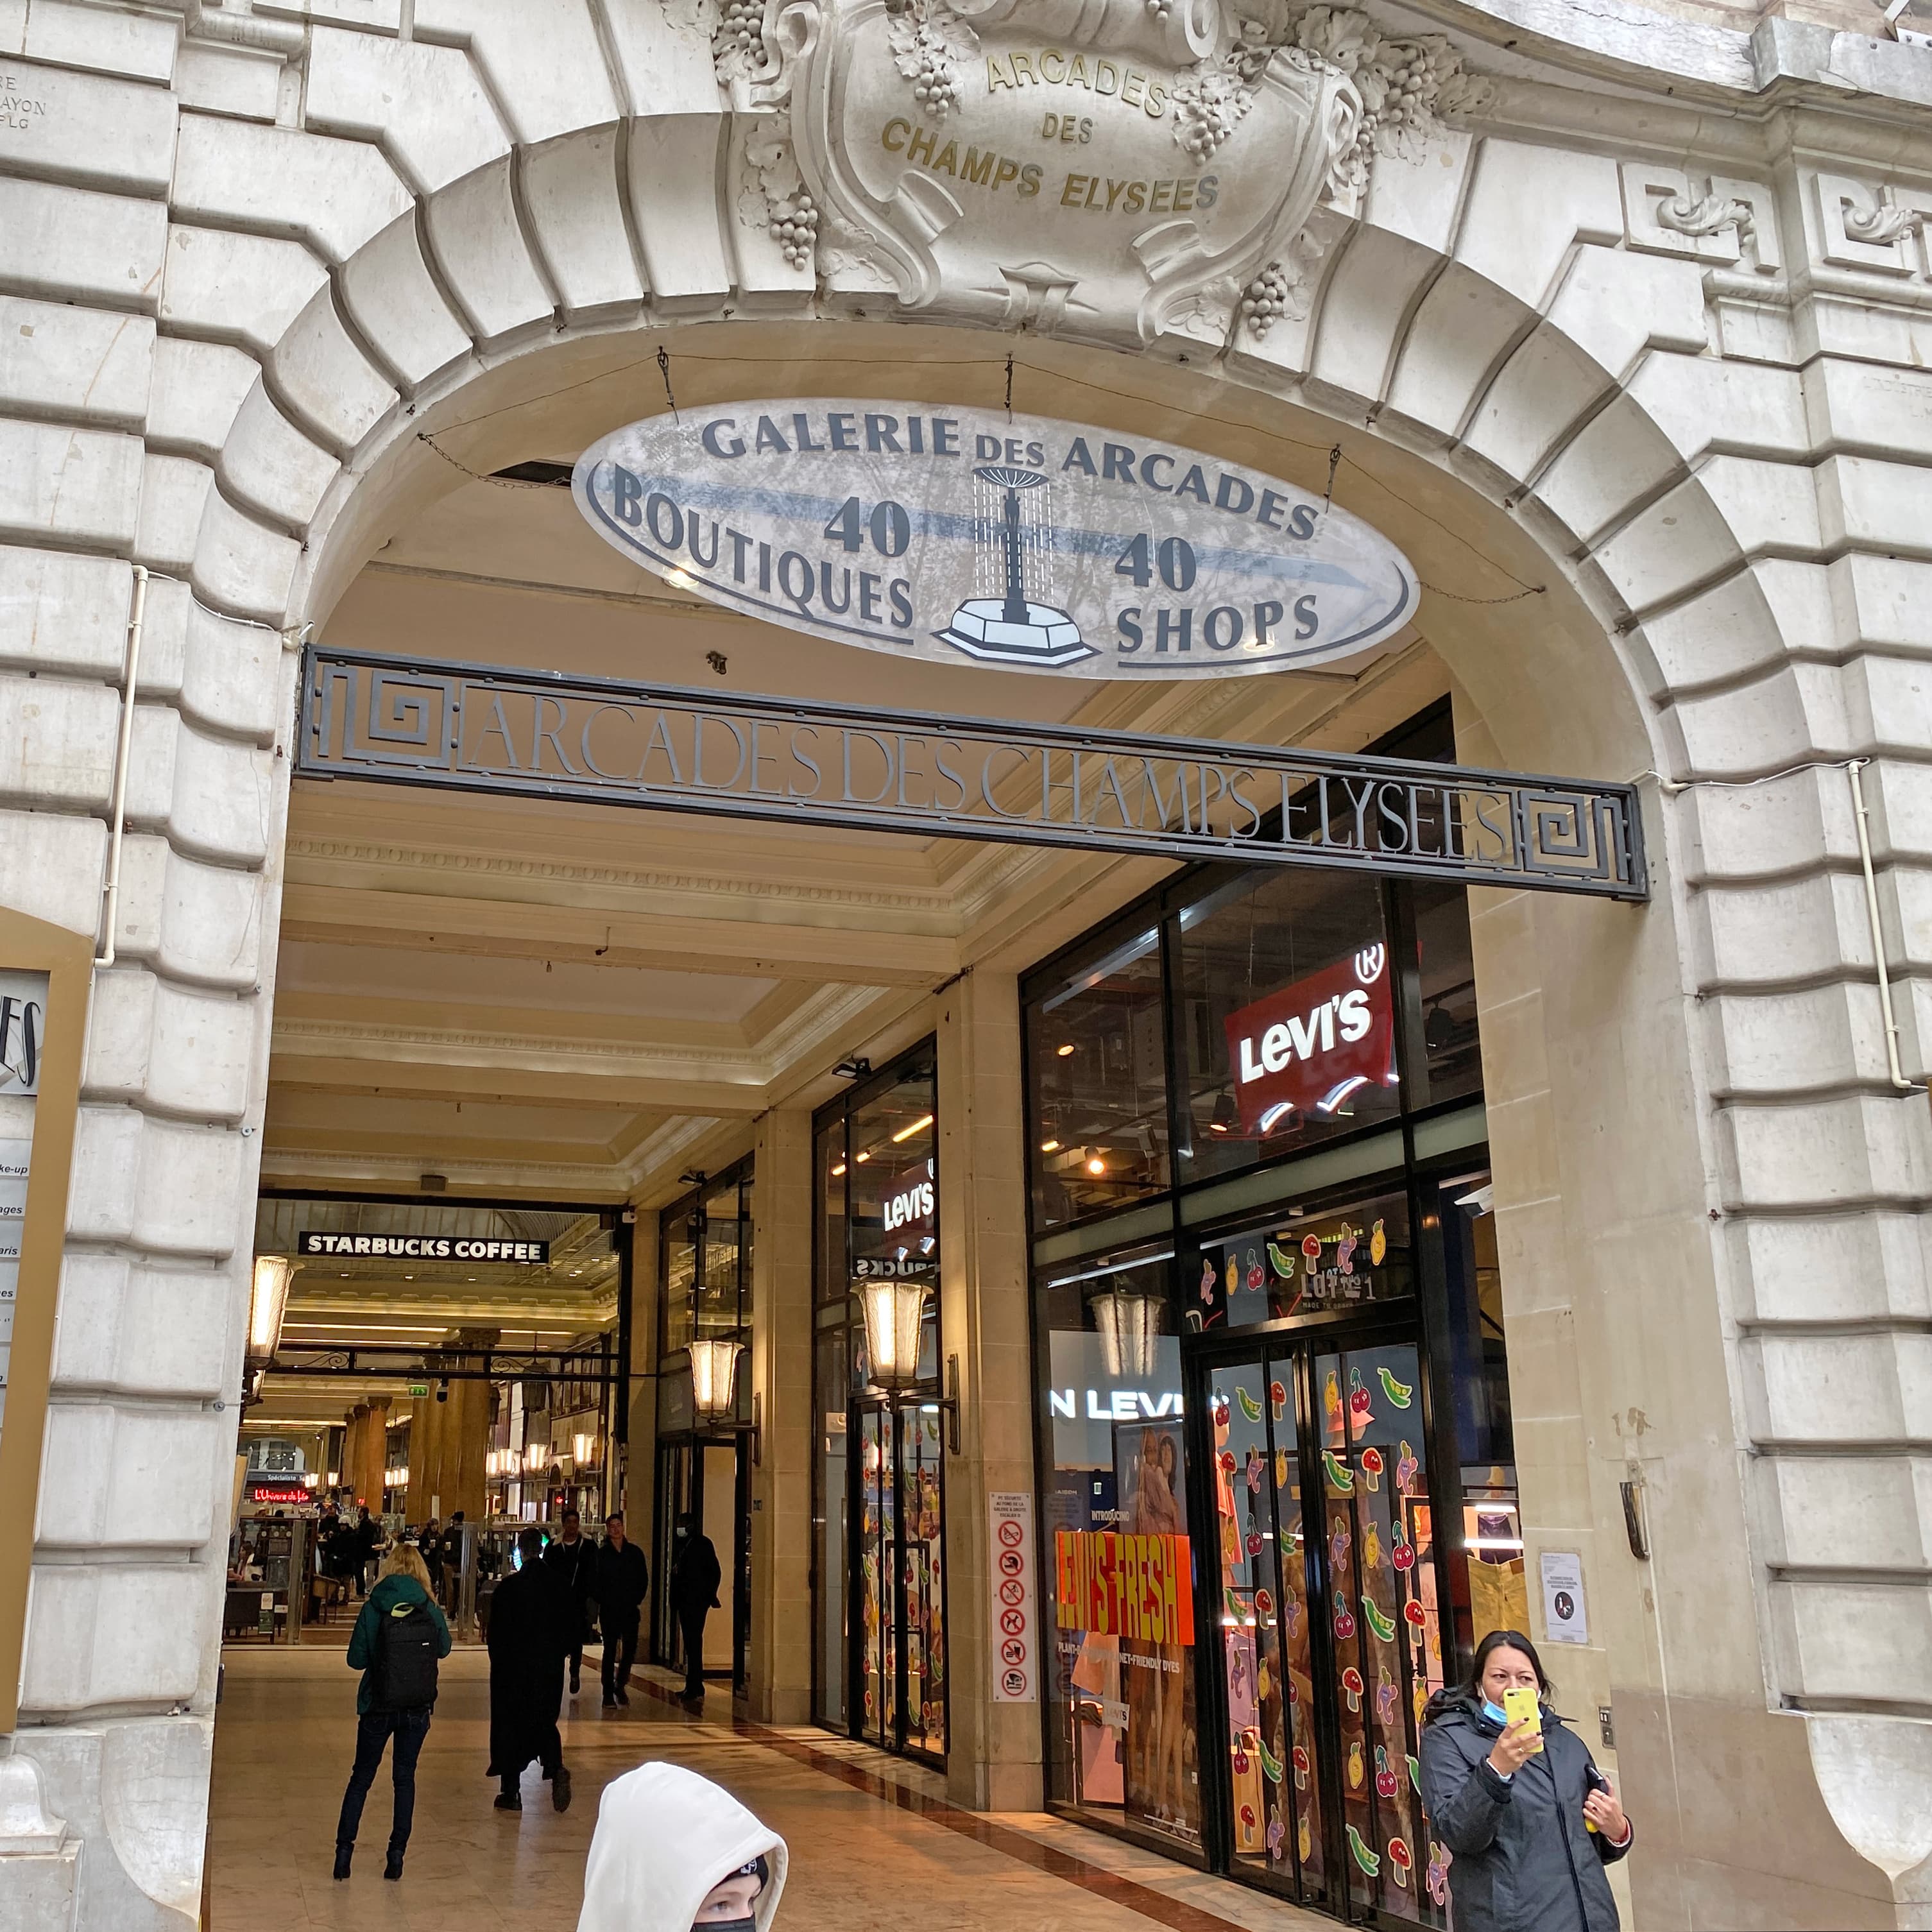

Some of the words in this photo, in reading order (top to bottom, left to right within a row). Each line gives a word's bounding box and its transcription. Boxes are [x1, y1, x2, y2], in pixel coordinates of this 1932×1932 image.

[986, 48, 1168, 118] ARCADES
[1042, 112, 1093, 144] DES
[881, 117, 1044, 197] CHAMPS
[1060, 173, 1219, 215] ELYSEES
[702, 413, 961, 459] GALERIE
[975, 434, 1045, 467] DES
[1061, 436, 1319, 541] ARCADES
[613, 463, 914, 628] BOUTIQUES
[824, 496, 910, 558] 40
[1115, 533, 1197, 592] 40
[1117, 594, 1319, 653] SHOPS
[468, 693, 824, 798] ARCADES
[841, 730, 966, 812] DES
[981, 746, 1262, 839] CHAMPS
[1279, 772, 1509, 862] ELYSEES
[307, 1235, 450, 1258] STARBUCKS
[454, 1240, 542, 1261] COFFEE
[1091, 1509, 1130, 1522] INTRODUCING
[1115, 1534, 1179, 1645] FRESH
[1119, 1652, 1161, 1670] NET-FRIENDLY
[1163, 1659, 1181, 1674] DYES
